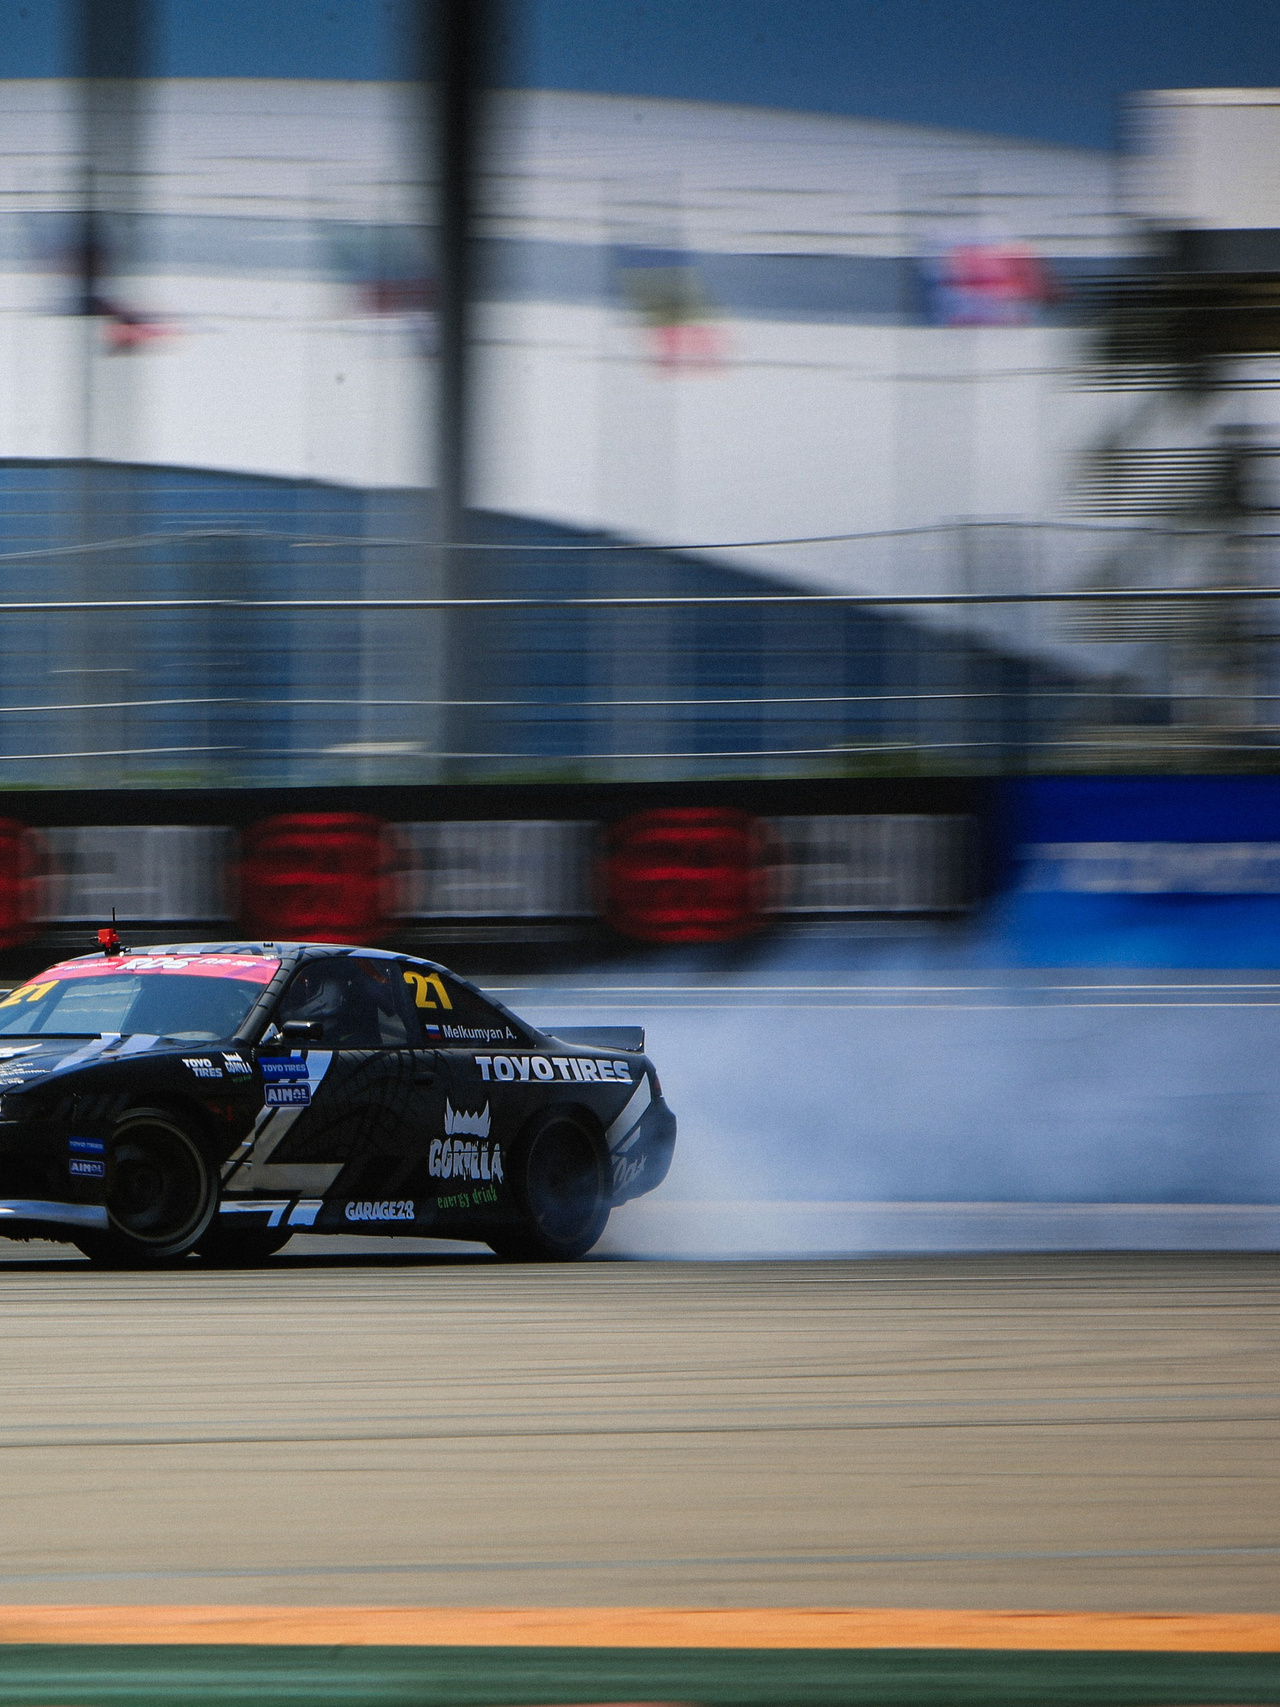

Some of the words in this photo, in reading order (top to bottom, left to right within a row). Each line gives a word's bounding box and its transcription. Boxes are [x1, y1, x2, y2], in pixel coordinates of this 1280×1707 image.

[116, 957, 203, 970] RDS
[403, 971, 453, 1010] 21
[442, 1025, 504, 1042] Melkumyan
[505, 1026, 518, 1040] A.
[182, 1058, 212, 1068] TOYO
[262, 1064, 284, 1072] TOYO
[284, 1064, 307, 1072] TIRES
[474, 1056, 554, 1081] TOYO
[551, 1057, 634, 1085] TIRES
[192, 1068, 223, 1078] TIRES
[267, 1088, 309, 1102] AIMOL
[429, 1138, 504, 1184] GORILLA
[437, 1192, 470, 1208] energy
[472, 1184, 498, 1204] drink
[345, 1200, 415, 1220] GARAGE28
